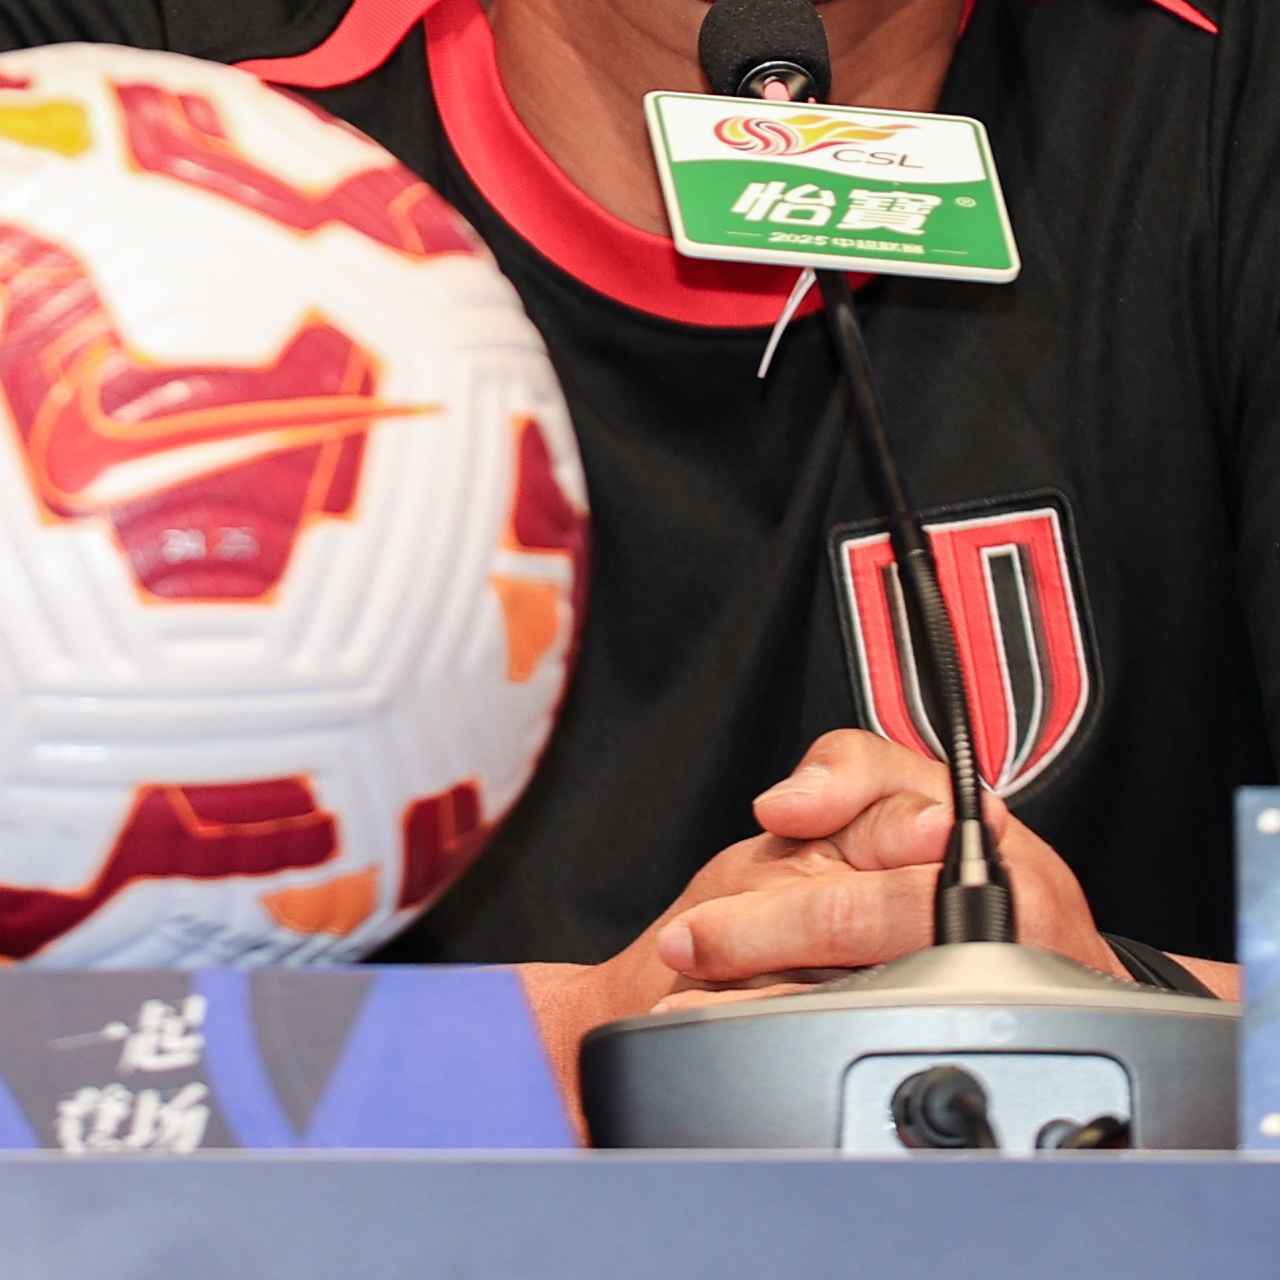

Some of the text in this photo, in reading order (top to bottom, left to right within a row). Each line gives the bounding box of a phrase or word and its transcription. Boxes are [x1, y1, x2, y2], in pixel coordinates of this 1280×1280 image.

[831, 148, 925, 169] CSL
[731, 180, 942, 235] 怡寶
[768, 231, 830, 247] 2025
